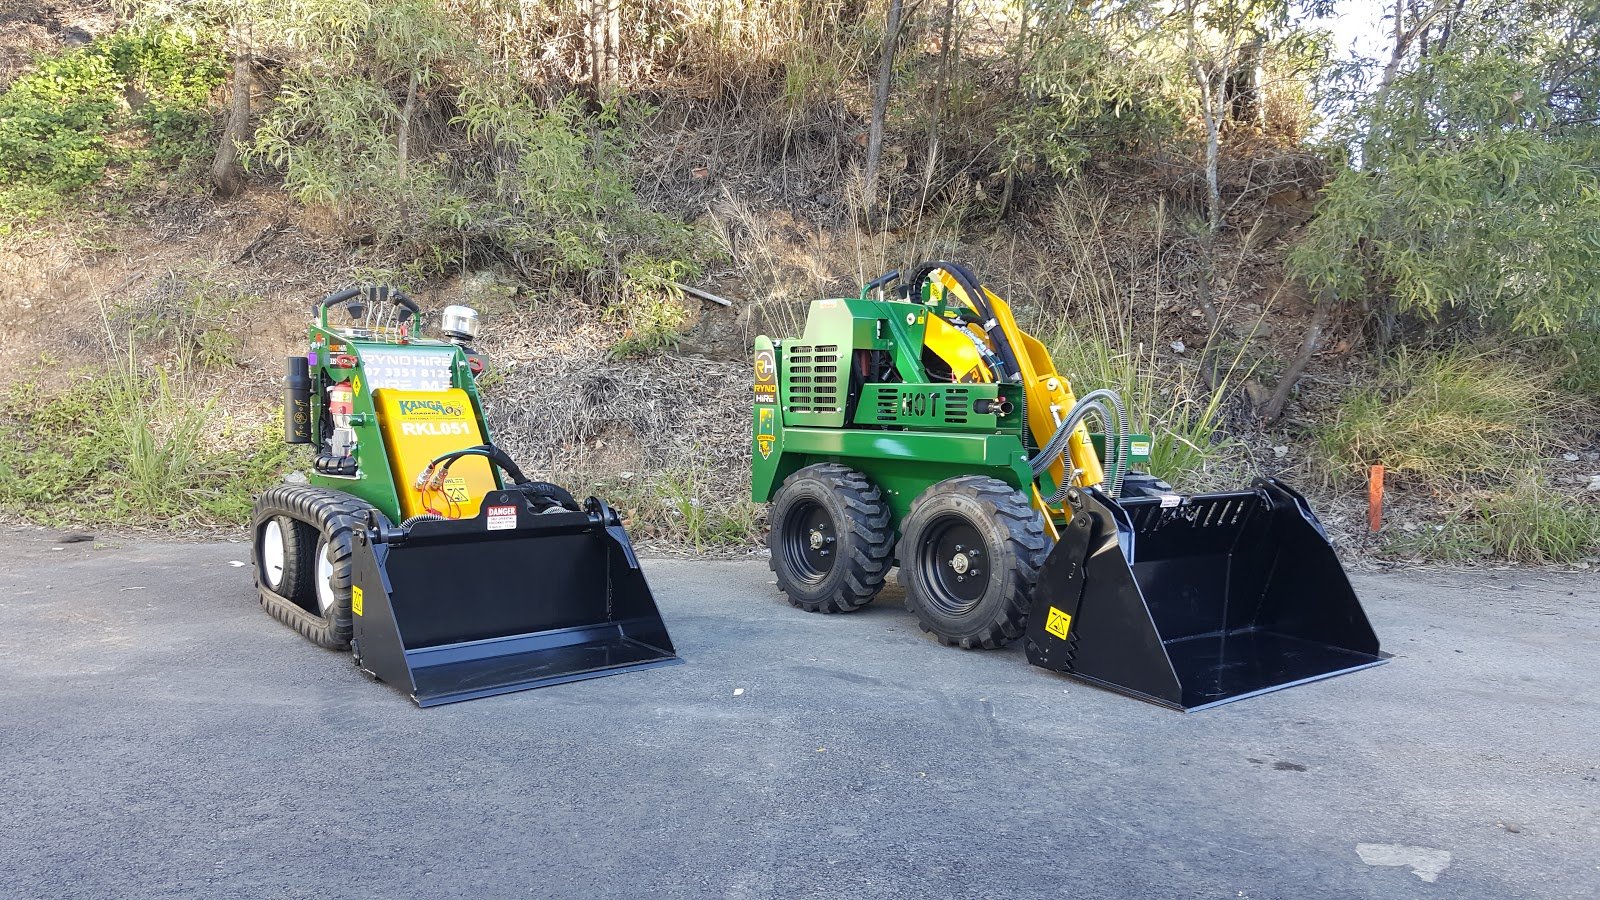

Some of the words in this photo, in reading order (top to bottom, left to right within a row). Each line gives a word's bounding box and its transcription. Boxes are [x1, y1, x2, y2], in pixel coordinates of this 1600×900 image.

[363, 355, 411, 366] RYNO
[366, 367, 381, 377] 07
[384, 367, 416, 378] 3351
[420, 368, 452, 378] 8125
[754, 384, 776, 392] RYNO
[398, 400, 447, 416] KANGA
[901, 391, 941, 418] HOT
[401, 421, 470, 436] RKL051
[488, 507, 516, 516] DANGER
